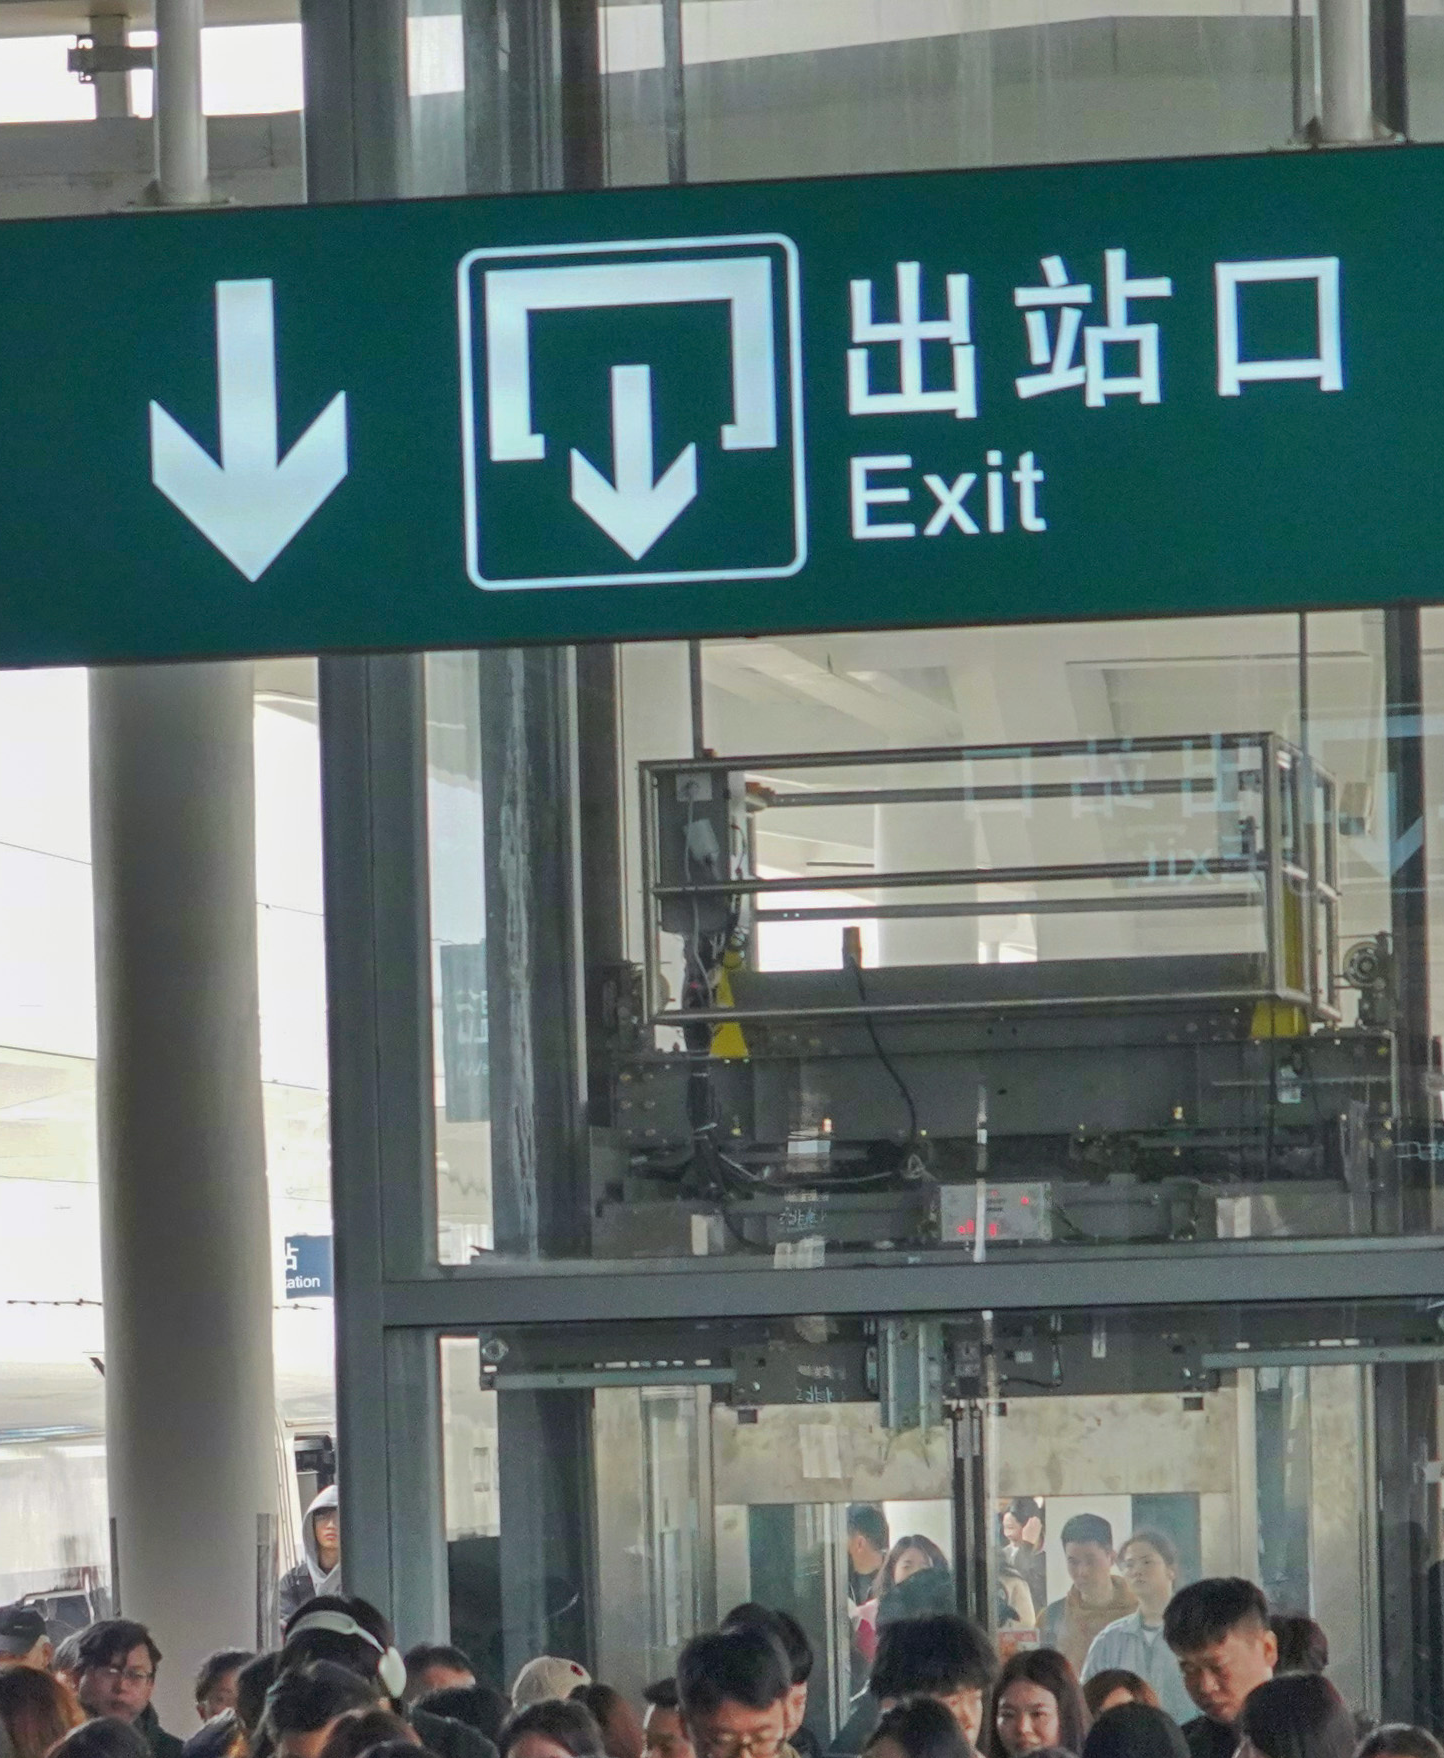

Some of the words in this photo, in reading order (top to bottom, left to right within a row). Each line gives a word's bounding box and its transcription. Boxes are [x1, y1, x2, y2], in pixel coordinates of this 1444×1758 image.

[847, 248, 1344, 419] 出站口
[850, 449, 1047, 540] Exit
